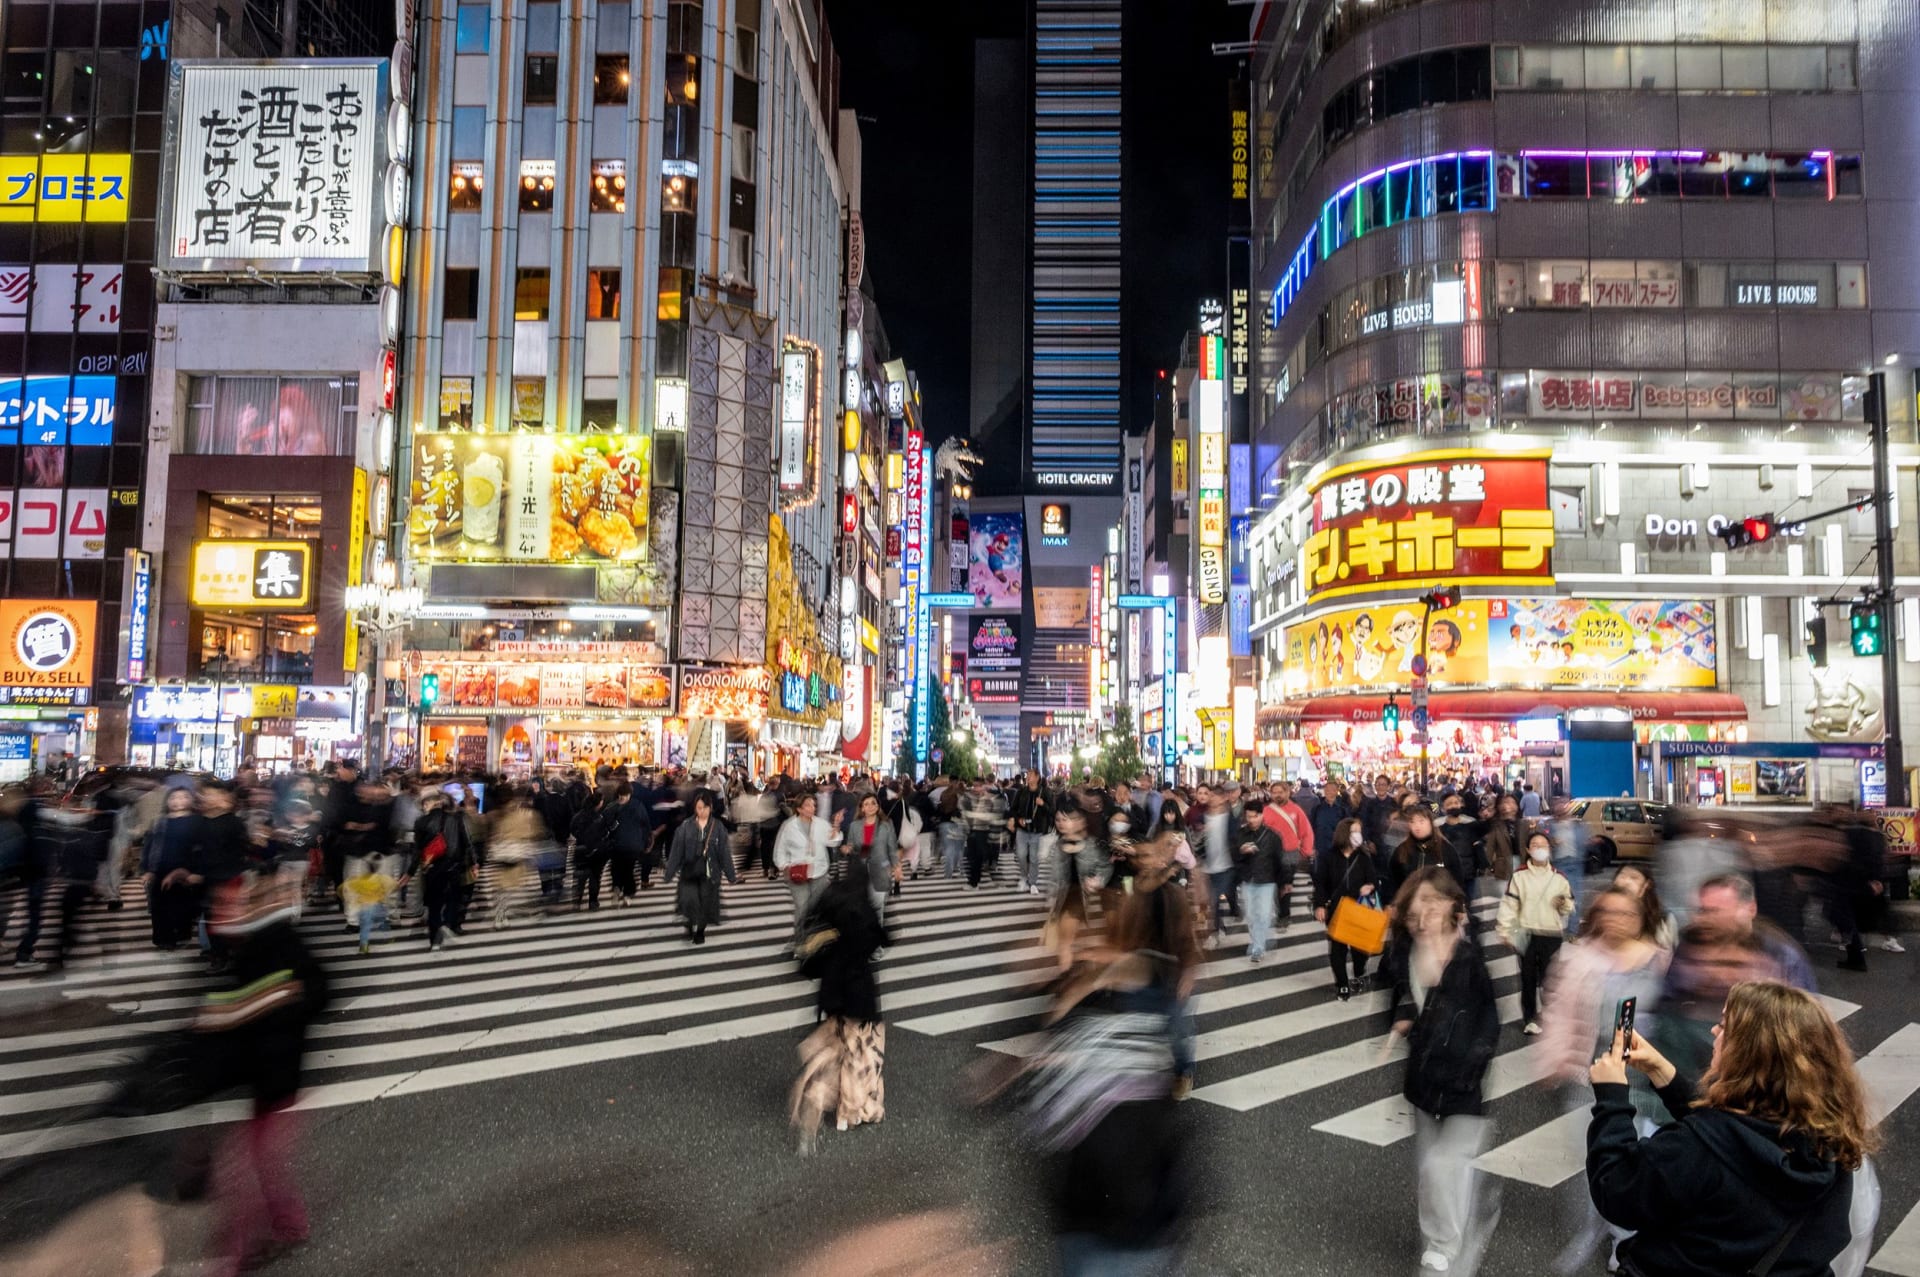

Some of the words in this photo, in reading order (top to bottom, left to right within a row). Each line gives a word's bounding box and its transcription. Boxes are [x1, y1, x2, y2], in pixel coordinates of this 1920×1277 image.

[236, 86, 299, 246] 酒と肴
[291, 103, 326, 243] こだわりの
[7, 172, 125, 201] プロミス
[190, 109, 242, 247] だけの店
[1552, 282, 1581, 305] 新宿
[1595, 280, 1634, 305] アイドル
[1639, 279, 1678, 305] ステージ
[1738, 285, 1772, 304] LIVE
[1777, 285, 1817, 304] HOUSE
[1363, 312, 1388, 333] LIVE
[1393, 302, 1432, 325] HOUSE
[1540, 378, 1635, 410] 免税店
[1644, 384, 1710, 408] Bebas
[1712, 385, 1776, 408] Cukai
[40, 431, 57, 442] 4F
[908, 434, 921, 544] カラオケ歌広場
[1038, 473, 1069, 485] HOTEL
[1070, 473, 1114, 485] GRACERY
[420, 444, 439, 549] レモンサワー
[1320, 463, 1487, 522] 驚安の殿堂
[521, 496, 538, 515] 光
[1645, 513, 1698, 536] Don
[1042, 537, 1069, 546] IMAX
[256, 551, 300, 597] 集
[1200, 550, 1222, 599] CASINO
[1267, 570, 1276, 587] Don
[1582, 629, 1624, 640] コレクション
[3, 671, 37, 683] BUY
[37, 674, 46, 683] &
[48, 671, 85, 684] SELL
[684, 672, 771, 692] OKONOMIYAKI
[984, 680, 1019, 691] MARUHAN
[688, 689, 763, 708] お好み焼き
[1353, 707, 1378, 720] Don
[1669, 743, 1731, 754] SUBNADE
[1865, 766, 1876, 782] P
